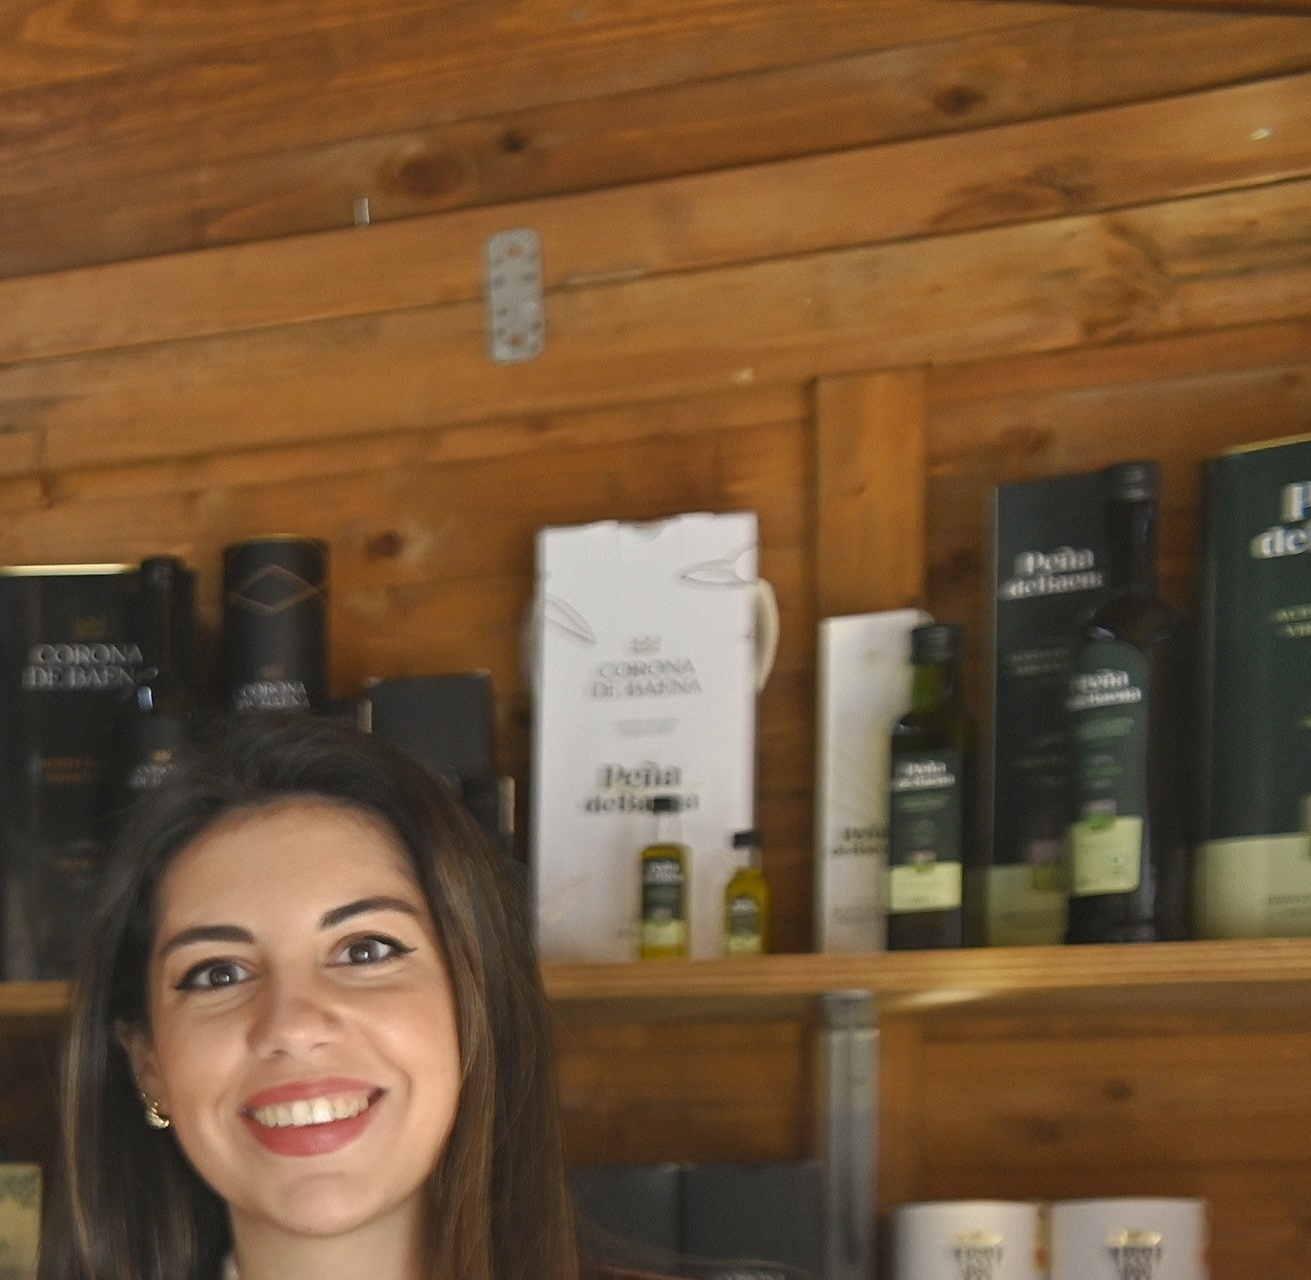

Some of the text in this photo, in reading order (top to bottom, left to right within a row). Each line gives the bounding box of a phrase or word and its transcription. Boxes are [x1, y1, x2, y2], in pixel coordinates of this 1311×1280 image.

[1282, 480, 1311, 522] P
[29, 644, 144, 664] CORONA
[67, 665, 135, 688] BAEN
